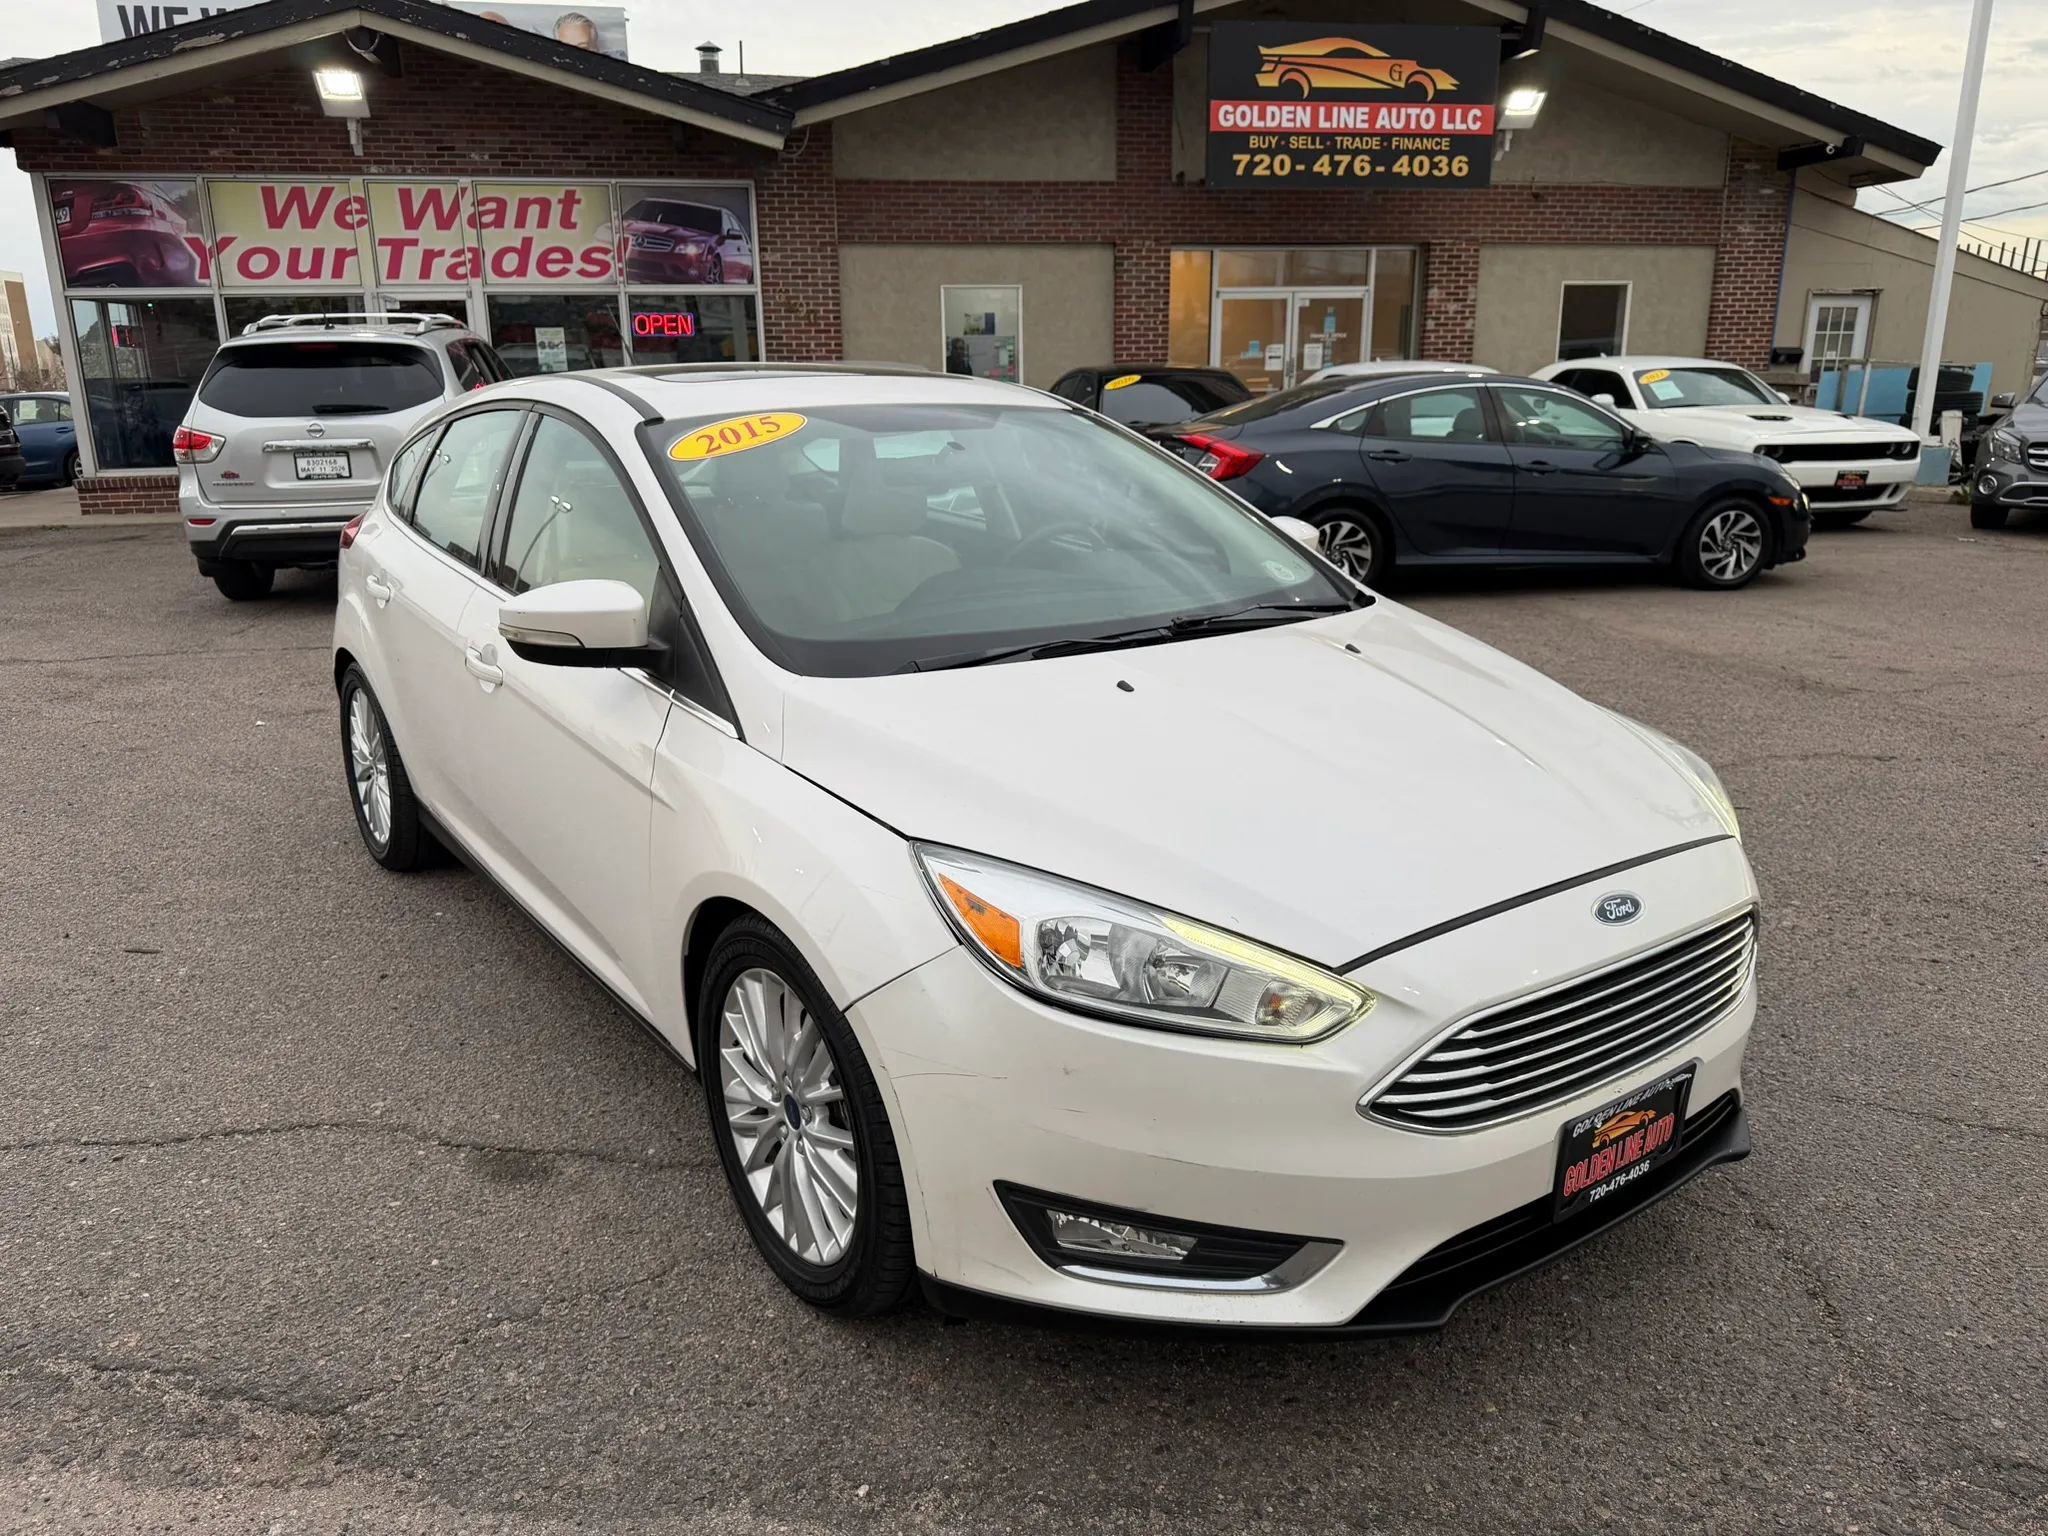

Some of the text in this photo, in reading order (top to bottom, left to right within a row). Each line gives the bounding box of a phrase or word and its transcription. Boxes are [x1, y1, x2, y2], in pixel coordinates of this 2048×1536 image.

[1218, 104, 1482, 131] GOLDEN LINE AUTO LLC
[1249, 136, 1450, 150] BUY SELL TRADE FINANCE
[260, 185, 581, 231] We Want
[183, 236, 630, 281] Your Trades!
[634, 314, 692, 336] OPEN
[696, 416, 781, 454] 2015
[1604, 898, 1635, 920] Ford
[1615, 1092, 1643, 1114] LINE
[1563, 1112, 1675, 1197] GOLDEN LINE AUTO
[1589, 1160, 1650, 1202] 720-476-4036
